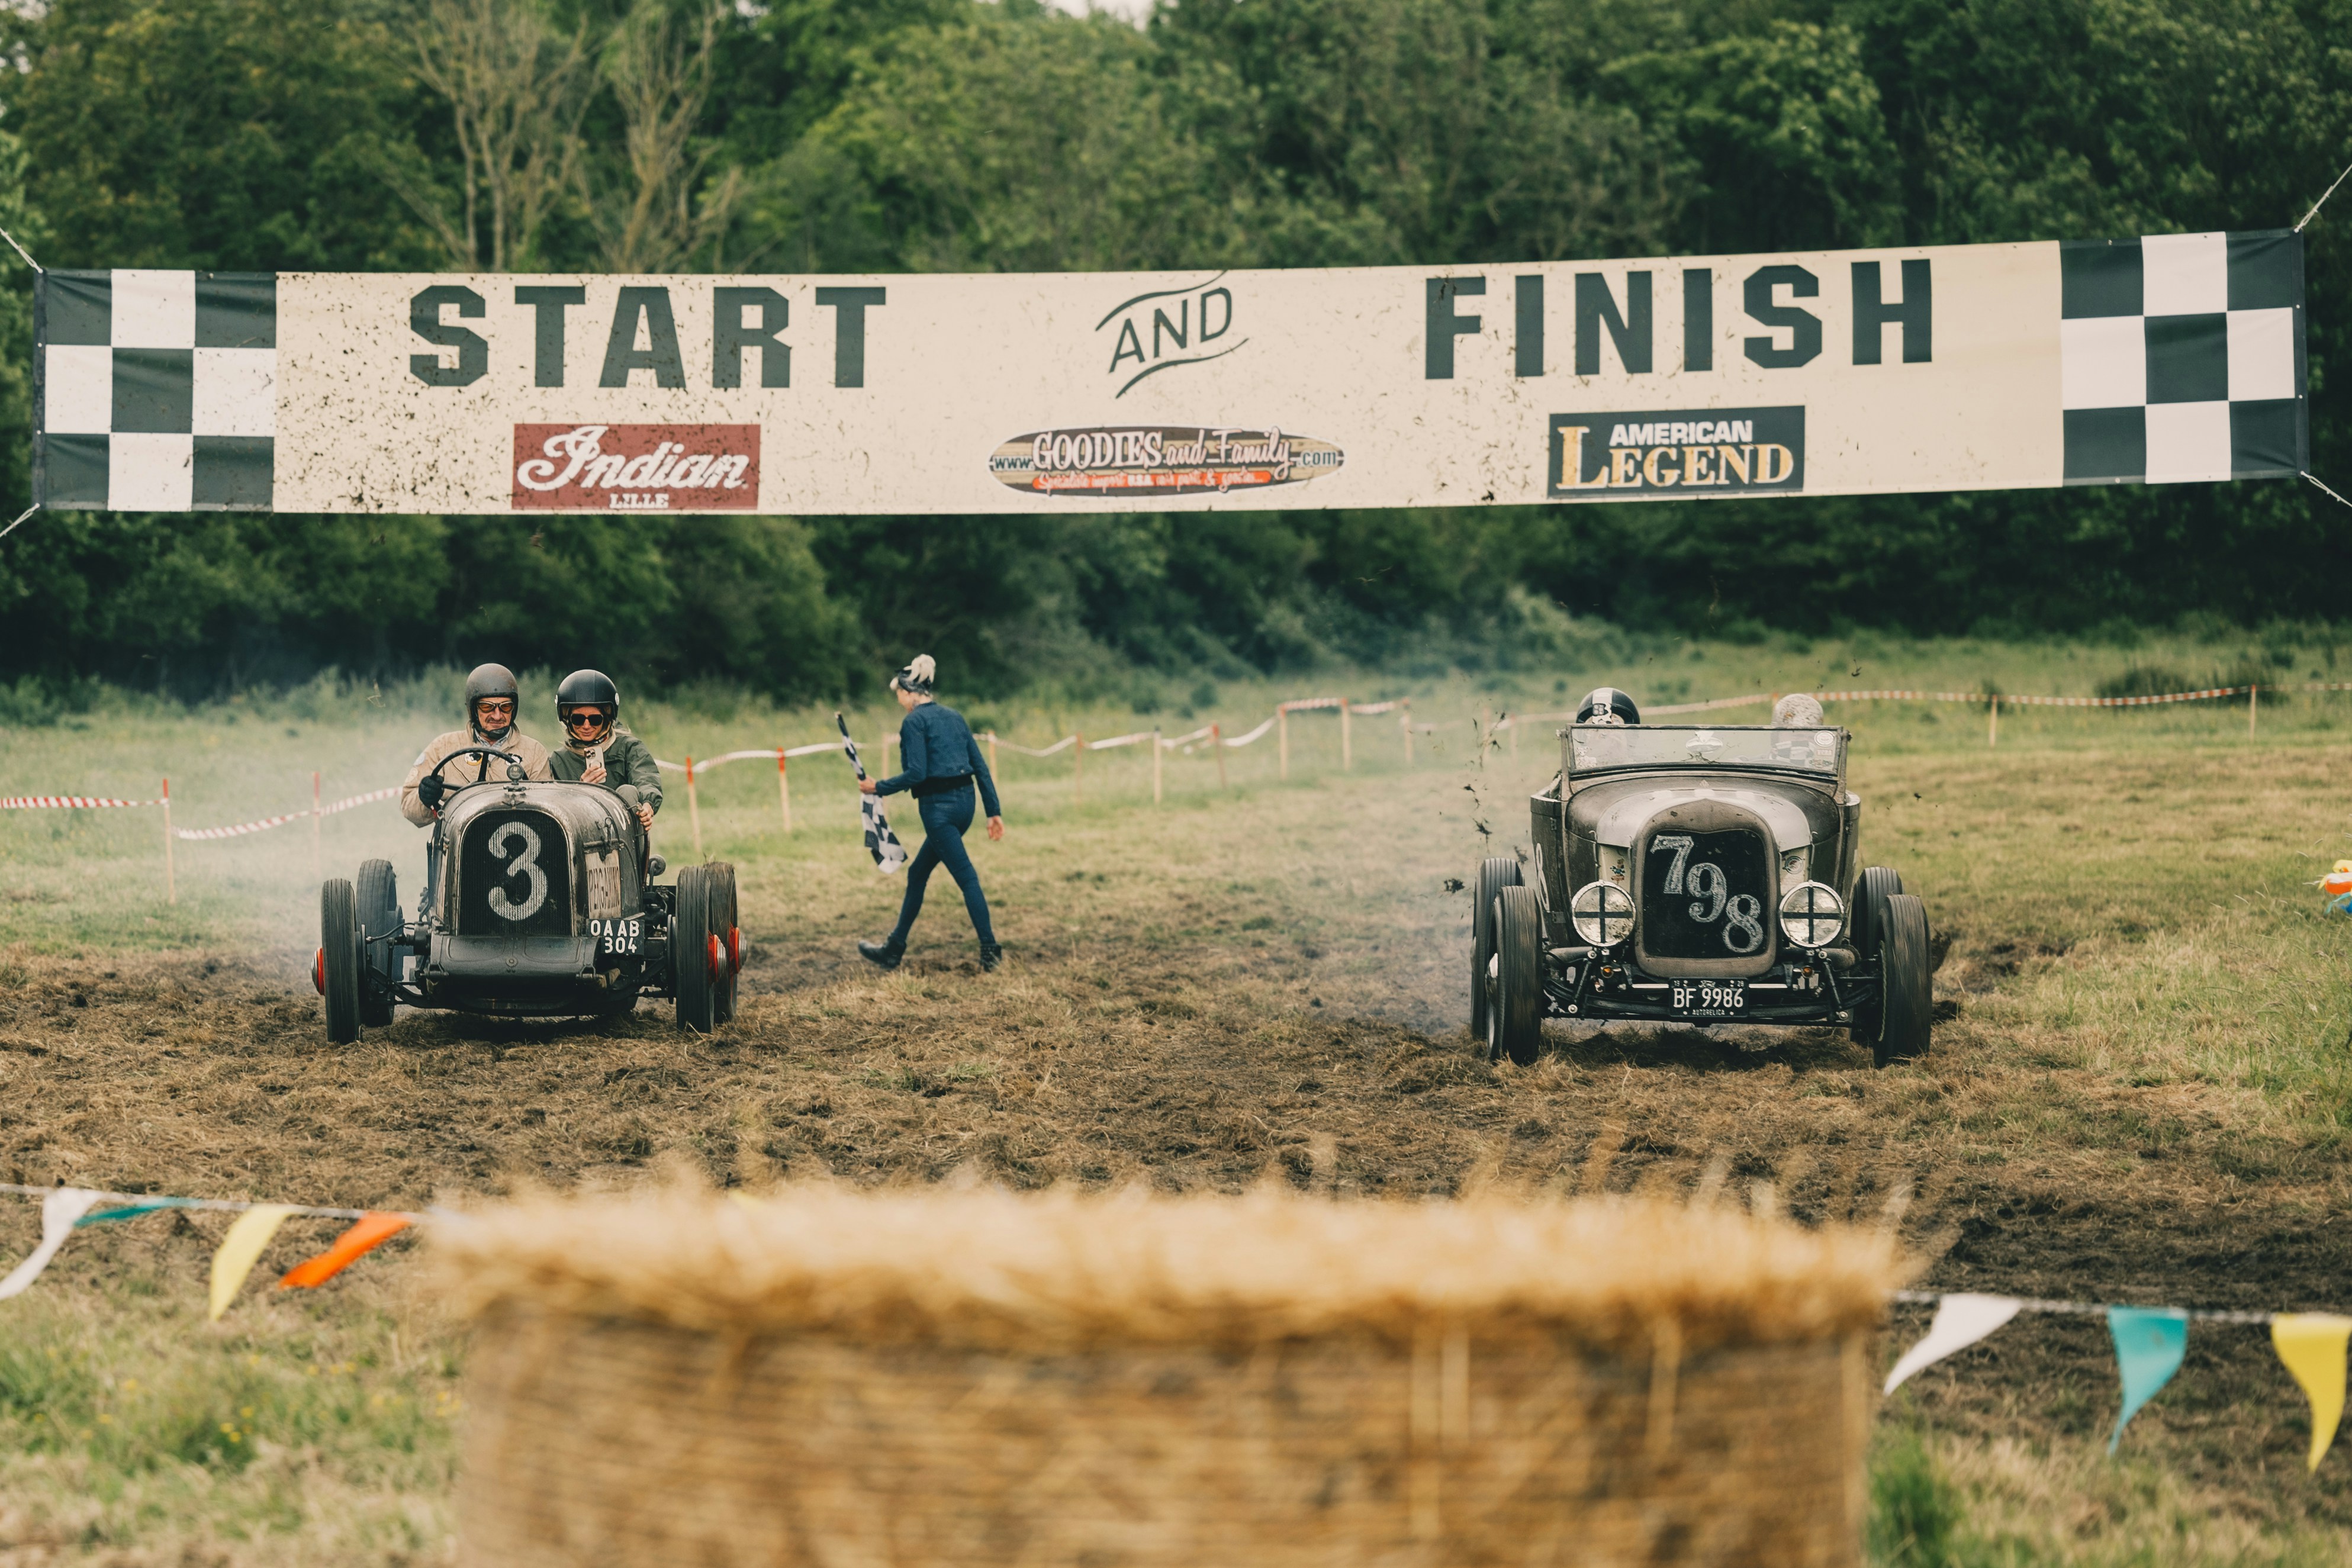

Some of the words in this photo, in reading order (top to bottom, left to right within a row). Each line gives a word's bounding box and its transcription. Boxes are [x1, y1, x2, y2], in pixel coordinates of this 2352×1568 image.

[410, 285, 887, 388] START
[1108, 286, 1233, 374] AND
[1425, 259, 1933, 379] FINISH
[517, 425, 750, 491] Indian
[1032, 430, 1163, 470] GOODIES
[1165, 429, 1207, 466] and
[1211, 426, 1294, 481] Family
[1556, 426, 1794, 490] LEGEND
[1608, 420, 1753, 447] AMERICAN
[609, 492, 670, 510] LILLE
[488, 821, 549, 921] 3
[604, 937, 638, 954] 304
[1673, 988, 1697, 1007] BF
[1701, 988, 1743, 1007] 9986
